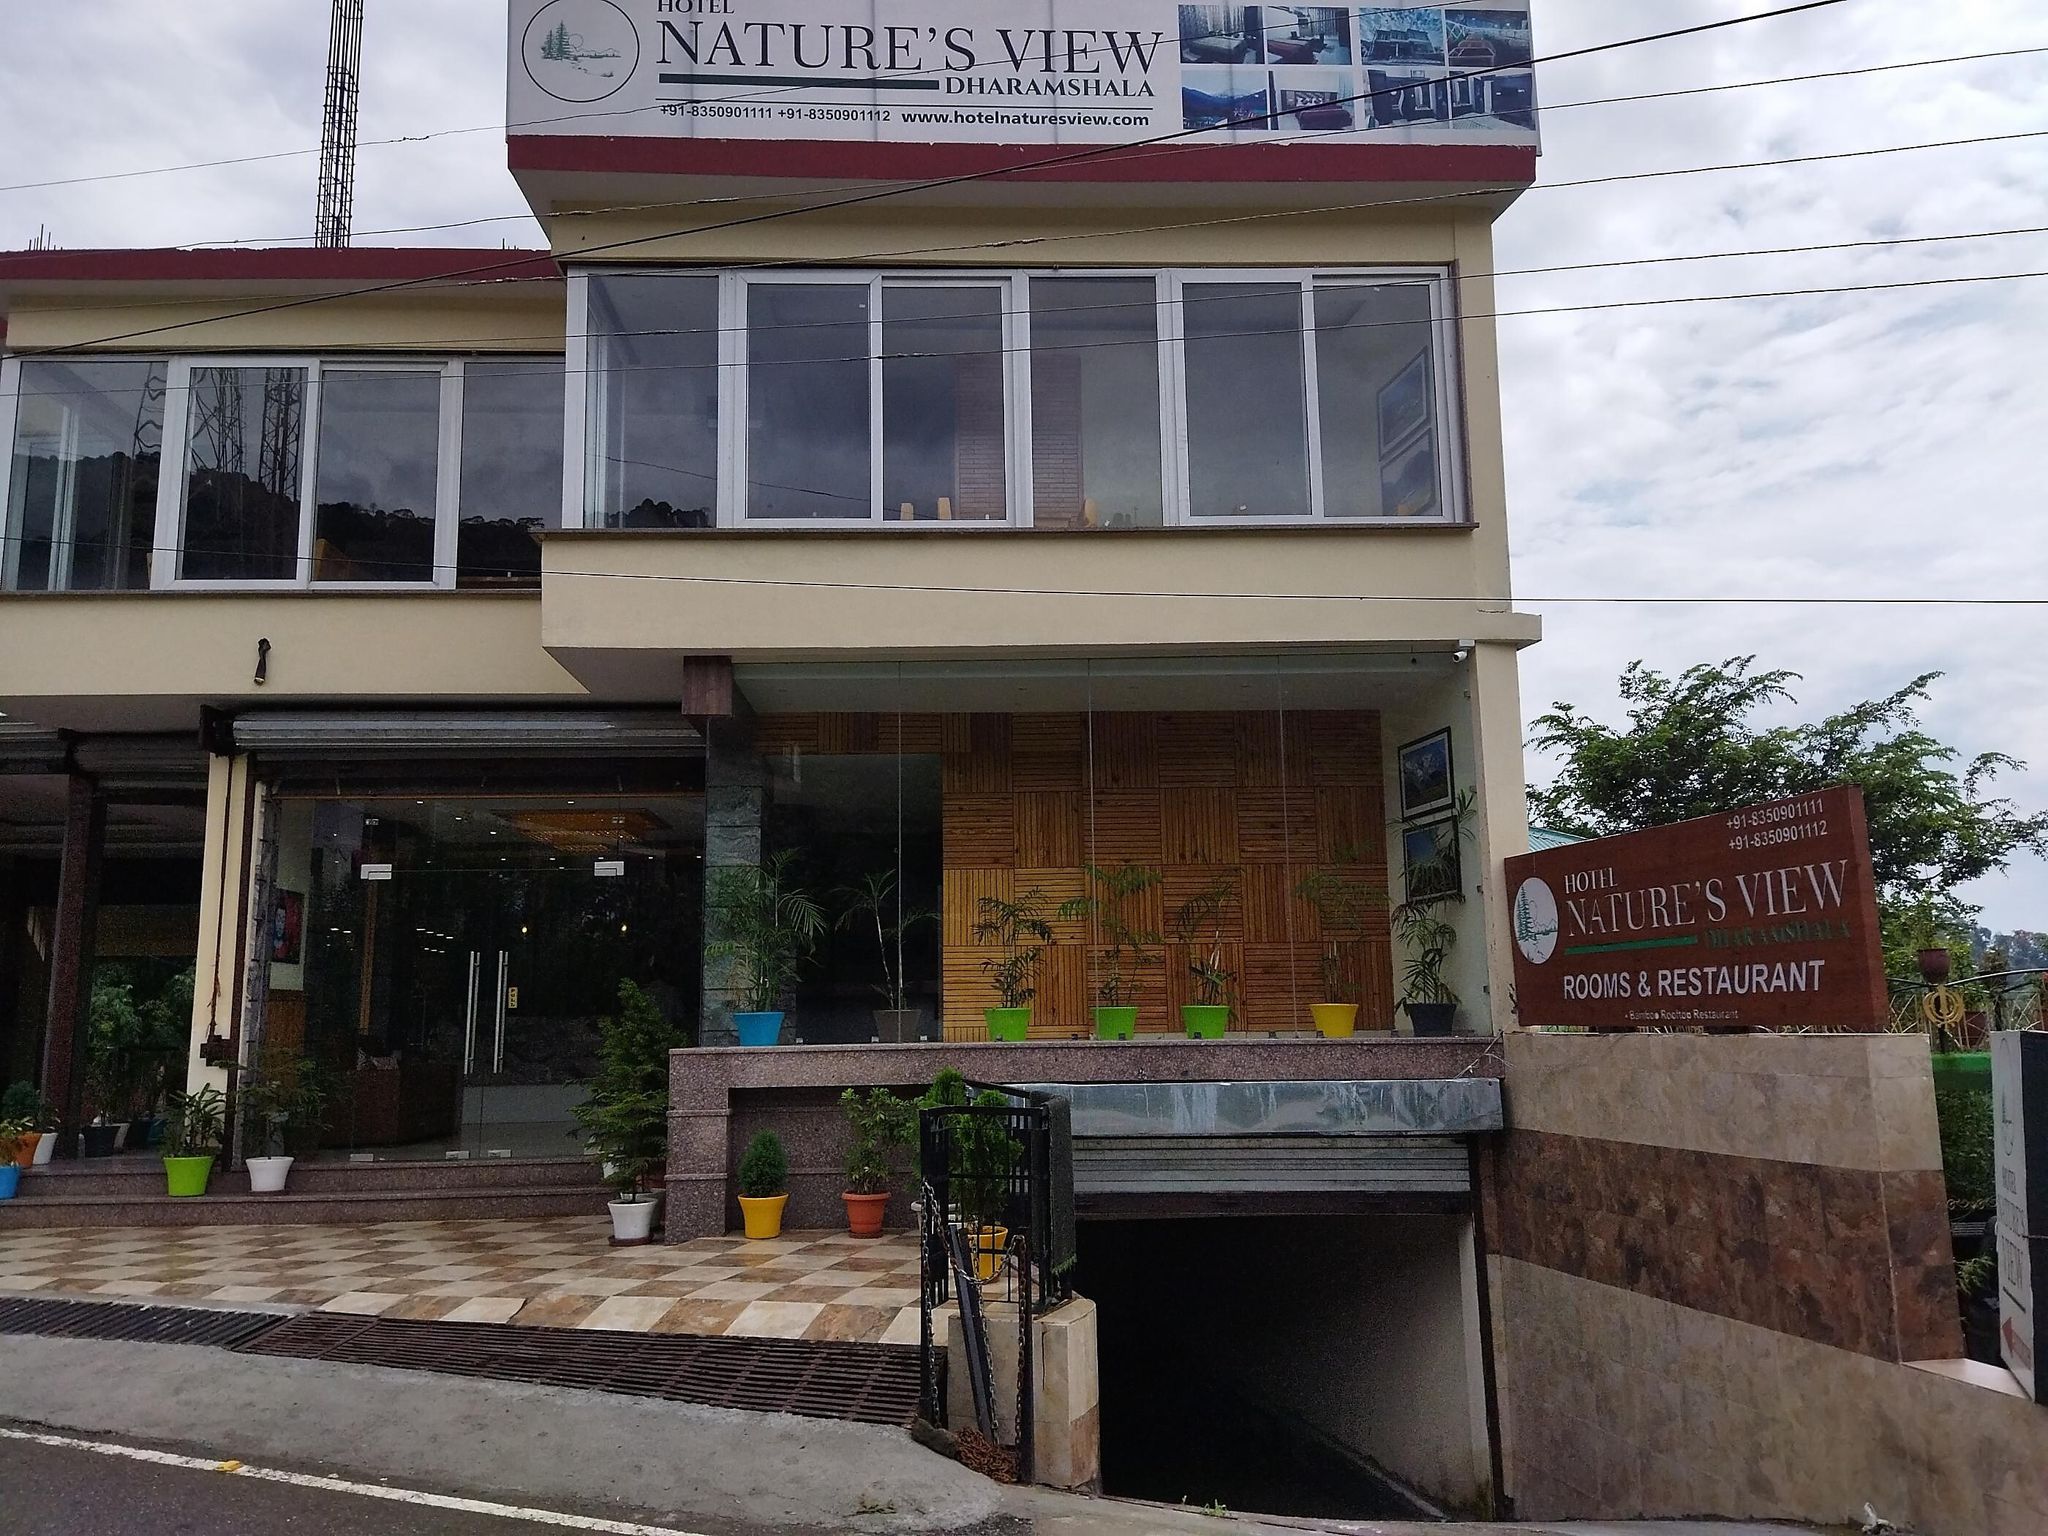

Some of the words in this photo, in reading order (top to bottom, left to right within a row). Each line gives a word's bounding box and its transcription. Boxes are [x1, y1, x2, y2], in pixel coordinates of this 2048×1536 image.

[657, 0, 735, 14] HOTEL
[656, 20, 976, 71] NATURE'S
[996, 29, 1164, 75] VIEW
[945, 77, 1155, 97] DHARAMSHALA
[661, 105, 772, 119] +91-8350901111
[778, 107, 890, 121] +91-8350901112
[902, 111, 1149, 126] www.hotelnaturesview.com
[1726, 798, 1823, 829] +91-8350901111
[1728, 820, 1828, 851] +91-8350901112
[1565, 867, 1618, 894] HOTEL
[1565, 878, 1727, 937] NATURE'S
[1735, 859, 1848, 918] VIEW
[1563, 972, 1631, 1000] ROOMS
[1638, 970, 1652, 997] &
[1658, 960, 1825, 996] RESTAURANT
